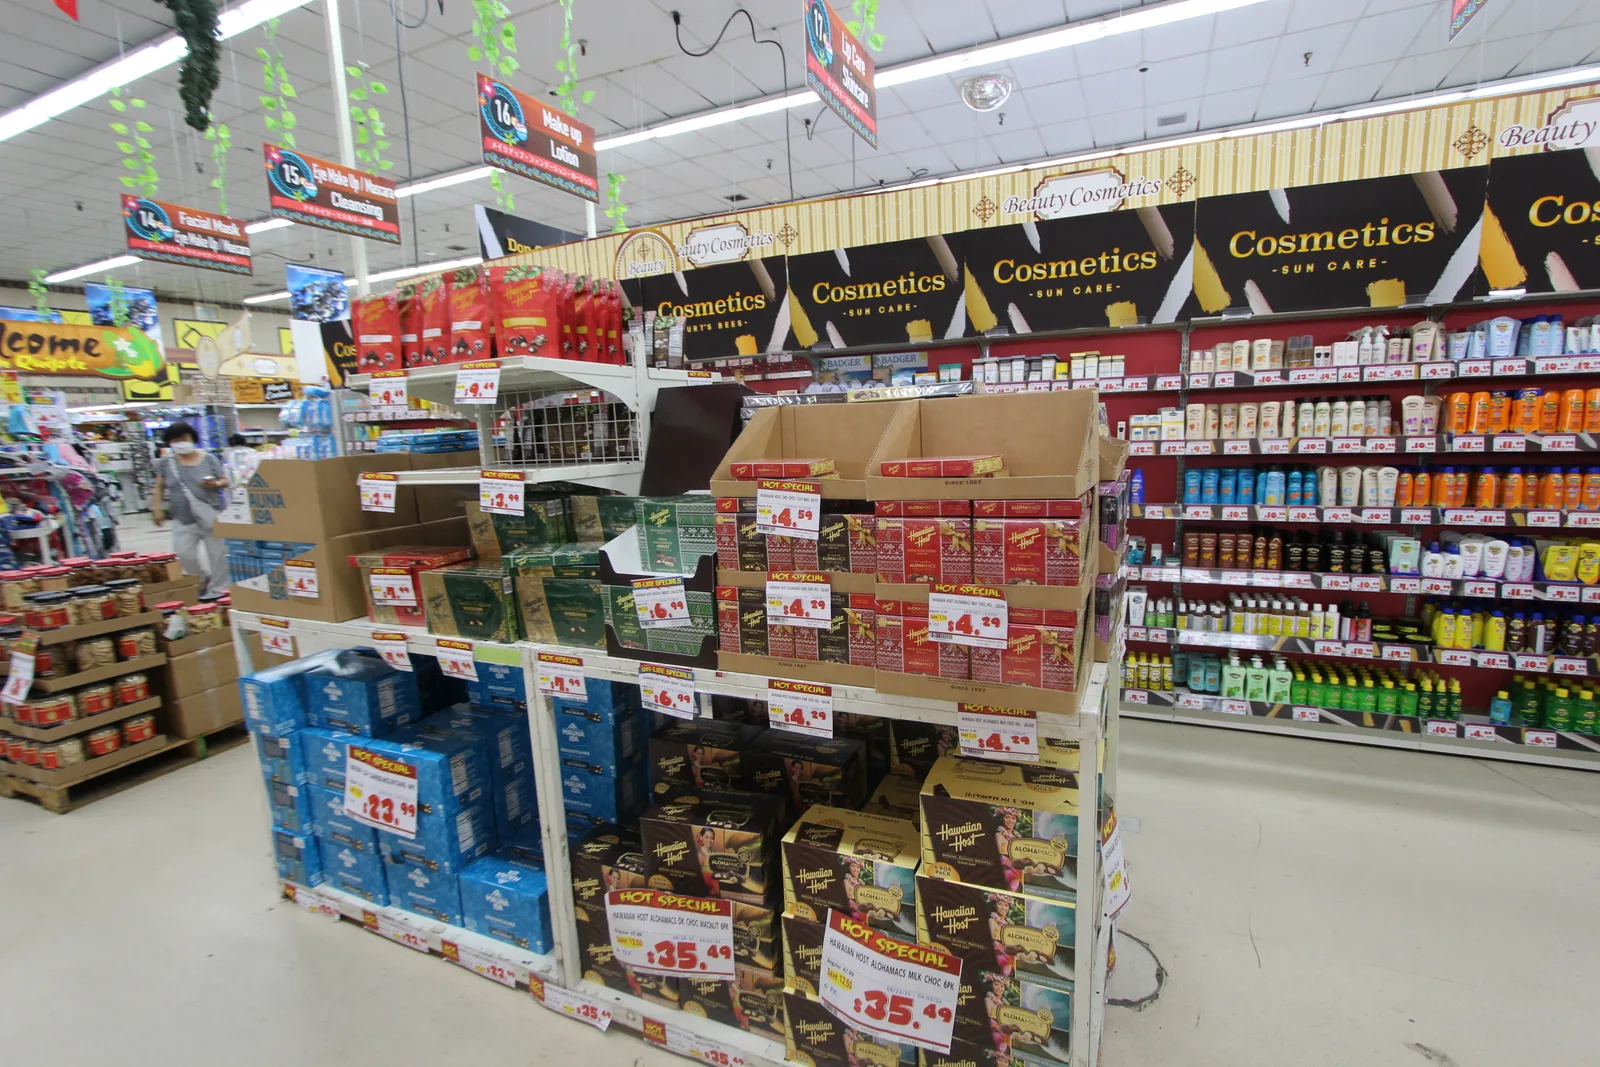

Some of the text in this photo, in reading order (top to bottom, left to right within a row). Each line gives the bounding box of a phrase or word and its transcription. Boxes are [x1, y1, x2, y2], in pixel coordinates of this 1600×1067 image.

[814, 9, 823, 41] 17
[842, 31, 866, 77] Lip Care
[842, 64, 869, 108] Skincare
[495, 99, 512, 126] 16
[542, 108, 583, 147] Make up
[1500, 119, 1597, 147] Beauty
[550, 139, 580, 168] Lotion
[281, 164, 299, 186] 15
[312, 163, 396, 200] Eye Make Up Mascara
[330, 192, 384, 221] Cleansing
[138, 210, 157, 228] 14
[178, 211, 240, 237] Facial Mask
[1229, 217, 1436, 258] Cosmetics
[673, 240, 710, 259] eauty
[627, 258, 666, 276] Beauty
[993, 247, 1157, 284] Cosmetics
[812, 271, 946, 305] Cosmetics
[657, 292, 766, 318] Cosmetics
[686, 323, 712, 333] URT'S
[826, 357, 862, 368] BADGER
[880, 353, 917, 364] BADGER
[782, 482, 815, 492] SPECIAL
[772, 508, 813, 527] $4.59
[826, 528, 846, 542] Host
[907, 525, 935, 541] Hawaiian
[917, 534, 936, 547] Host
[1008, 526, 1041, 542] Hawaiian
[1017, 536, 1042, 550] Host
[792, 573, 825, 582] SPECIAL
[936, 584, 1001, 597] HOT SPECIAL
[784, 598, 826, 617] $4.29
[948, 614, 1001, 635] $4.29
[1008, 633, 1036, 647] Hawaiian
[1016, 642, 1038, 655] Host
[540, 654, 580, 665] HOT SPECIAL
[774, 681, 826, 694] HOT SPECIAL
[654, 690, 691, 708] $6.99
[784, 708, 826, 726] $4.29
[964, 704, 1030, 716] HOT SPECIAL
[900, 736, 930, 750] Hawaiian
[978, 733, 1030, 751] $4.29
[908, 745, 930, 758] Host
[353, 749, 411, 775] HOT SPECIAL
[666, 763, 686, 774] Host
[936, 822, 982, 844] Hawaiian
[654, 840, 688, 855] Hawaiian
[948, 834, 986, 852] Host
[1014, 845, 1058, 859] ALOHAMACS
[663, 850, 690, 866] Host
[572, 878, 600, 890] Hawaiian
[796, 868, 833, 883] Hawaiian
[580, 887, 601, 900] Host
[806, 878, 836, 894] Host
[620, 891, 721, 913] HOT SPECIAL
[858, 891, 896, 906] ALOHAMACS
[637, 913, 649, 921] HOST
[650, 914, 677, 925] ALOHAMACS
[686, 918, 698, 928] CHOC
[930, 906, 976, 924] Hawaiian
[943, 916, 979, 934] Host
[840, 918, 874, 944] HOT
[876, 938, 948, 968] SPECIAL
[1006, 931, 1049, 946] ALOHAMACS
[647, 940, 731, 970] $35.49
[829, 937, 854, 957] HAWAIIAN
[855, 951, 870, 964] HOST
[870, 960, 906, 978] ALOHAMACS
[908, 971, 922, 982] MILK
[924, 975, 941, 987] CHOC
[944, 980, 955, 990] 6PK
[827, 959, 855, 977] Regular 47.99
[827, 968, 853, 990] Save 12.50
[830, 986, 838, 995] PK
[853, 990, 952, 1030] $35.49
[1002, 1010, 1043, 1028] ALOHAMACS
[646, 1022, 663, 1034] HOT
[796, 1020, 832, 1036] Hawaiian
[805, 1028, 835, 1045] Host
